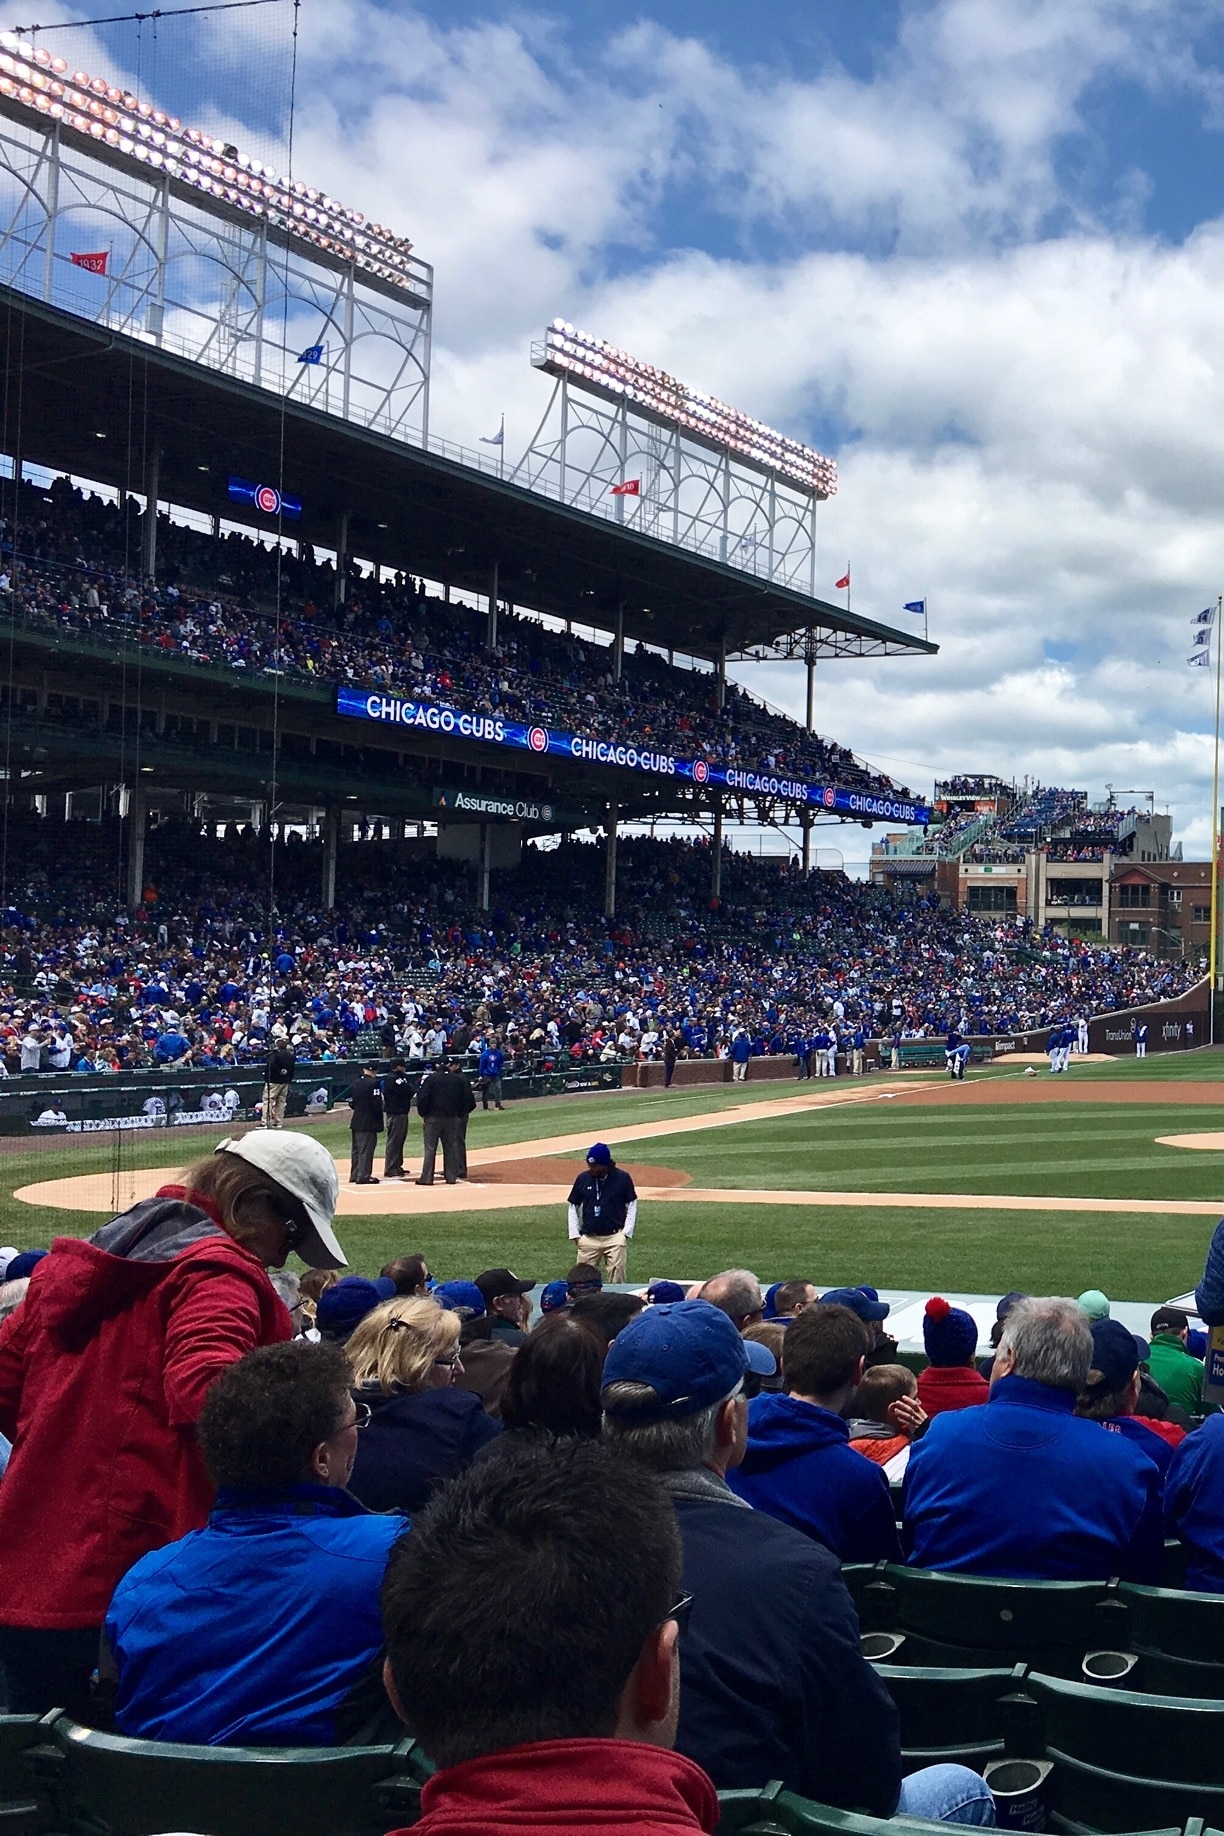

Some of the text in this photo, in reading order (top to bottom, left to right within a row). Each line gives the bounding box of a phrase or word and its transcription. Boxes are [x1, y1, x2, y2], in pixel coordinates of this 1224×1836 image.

[366, 695, 504, 742] CHICAGO CUBS
[571, 737, 675, 775] CHICAGO CUBS
[726, 768, 778, 794] CHICAGO
[780, 780, 808, 800] CUBS
[455, 792, 539, 819] Assurance Club
[850, 794, 893, 817] CHICAGO
[893, 802, 915, 821] CUBS
[1105, 1028, 1133, 1042] TransUnion
[1161, 1021, 1182, 1041] xfinity
